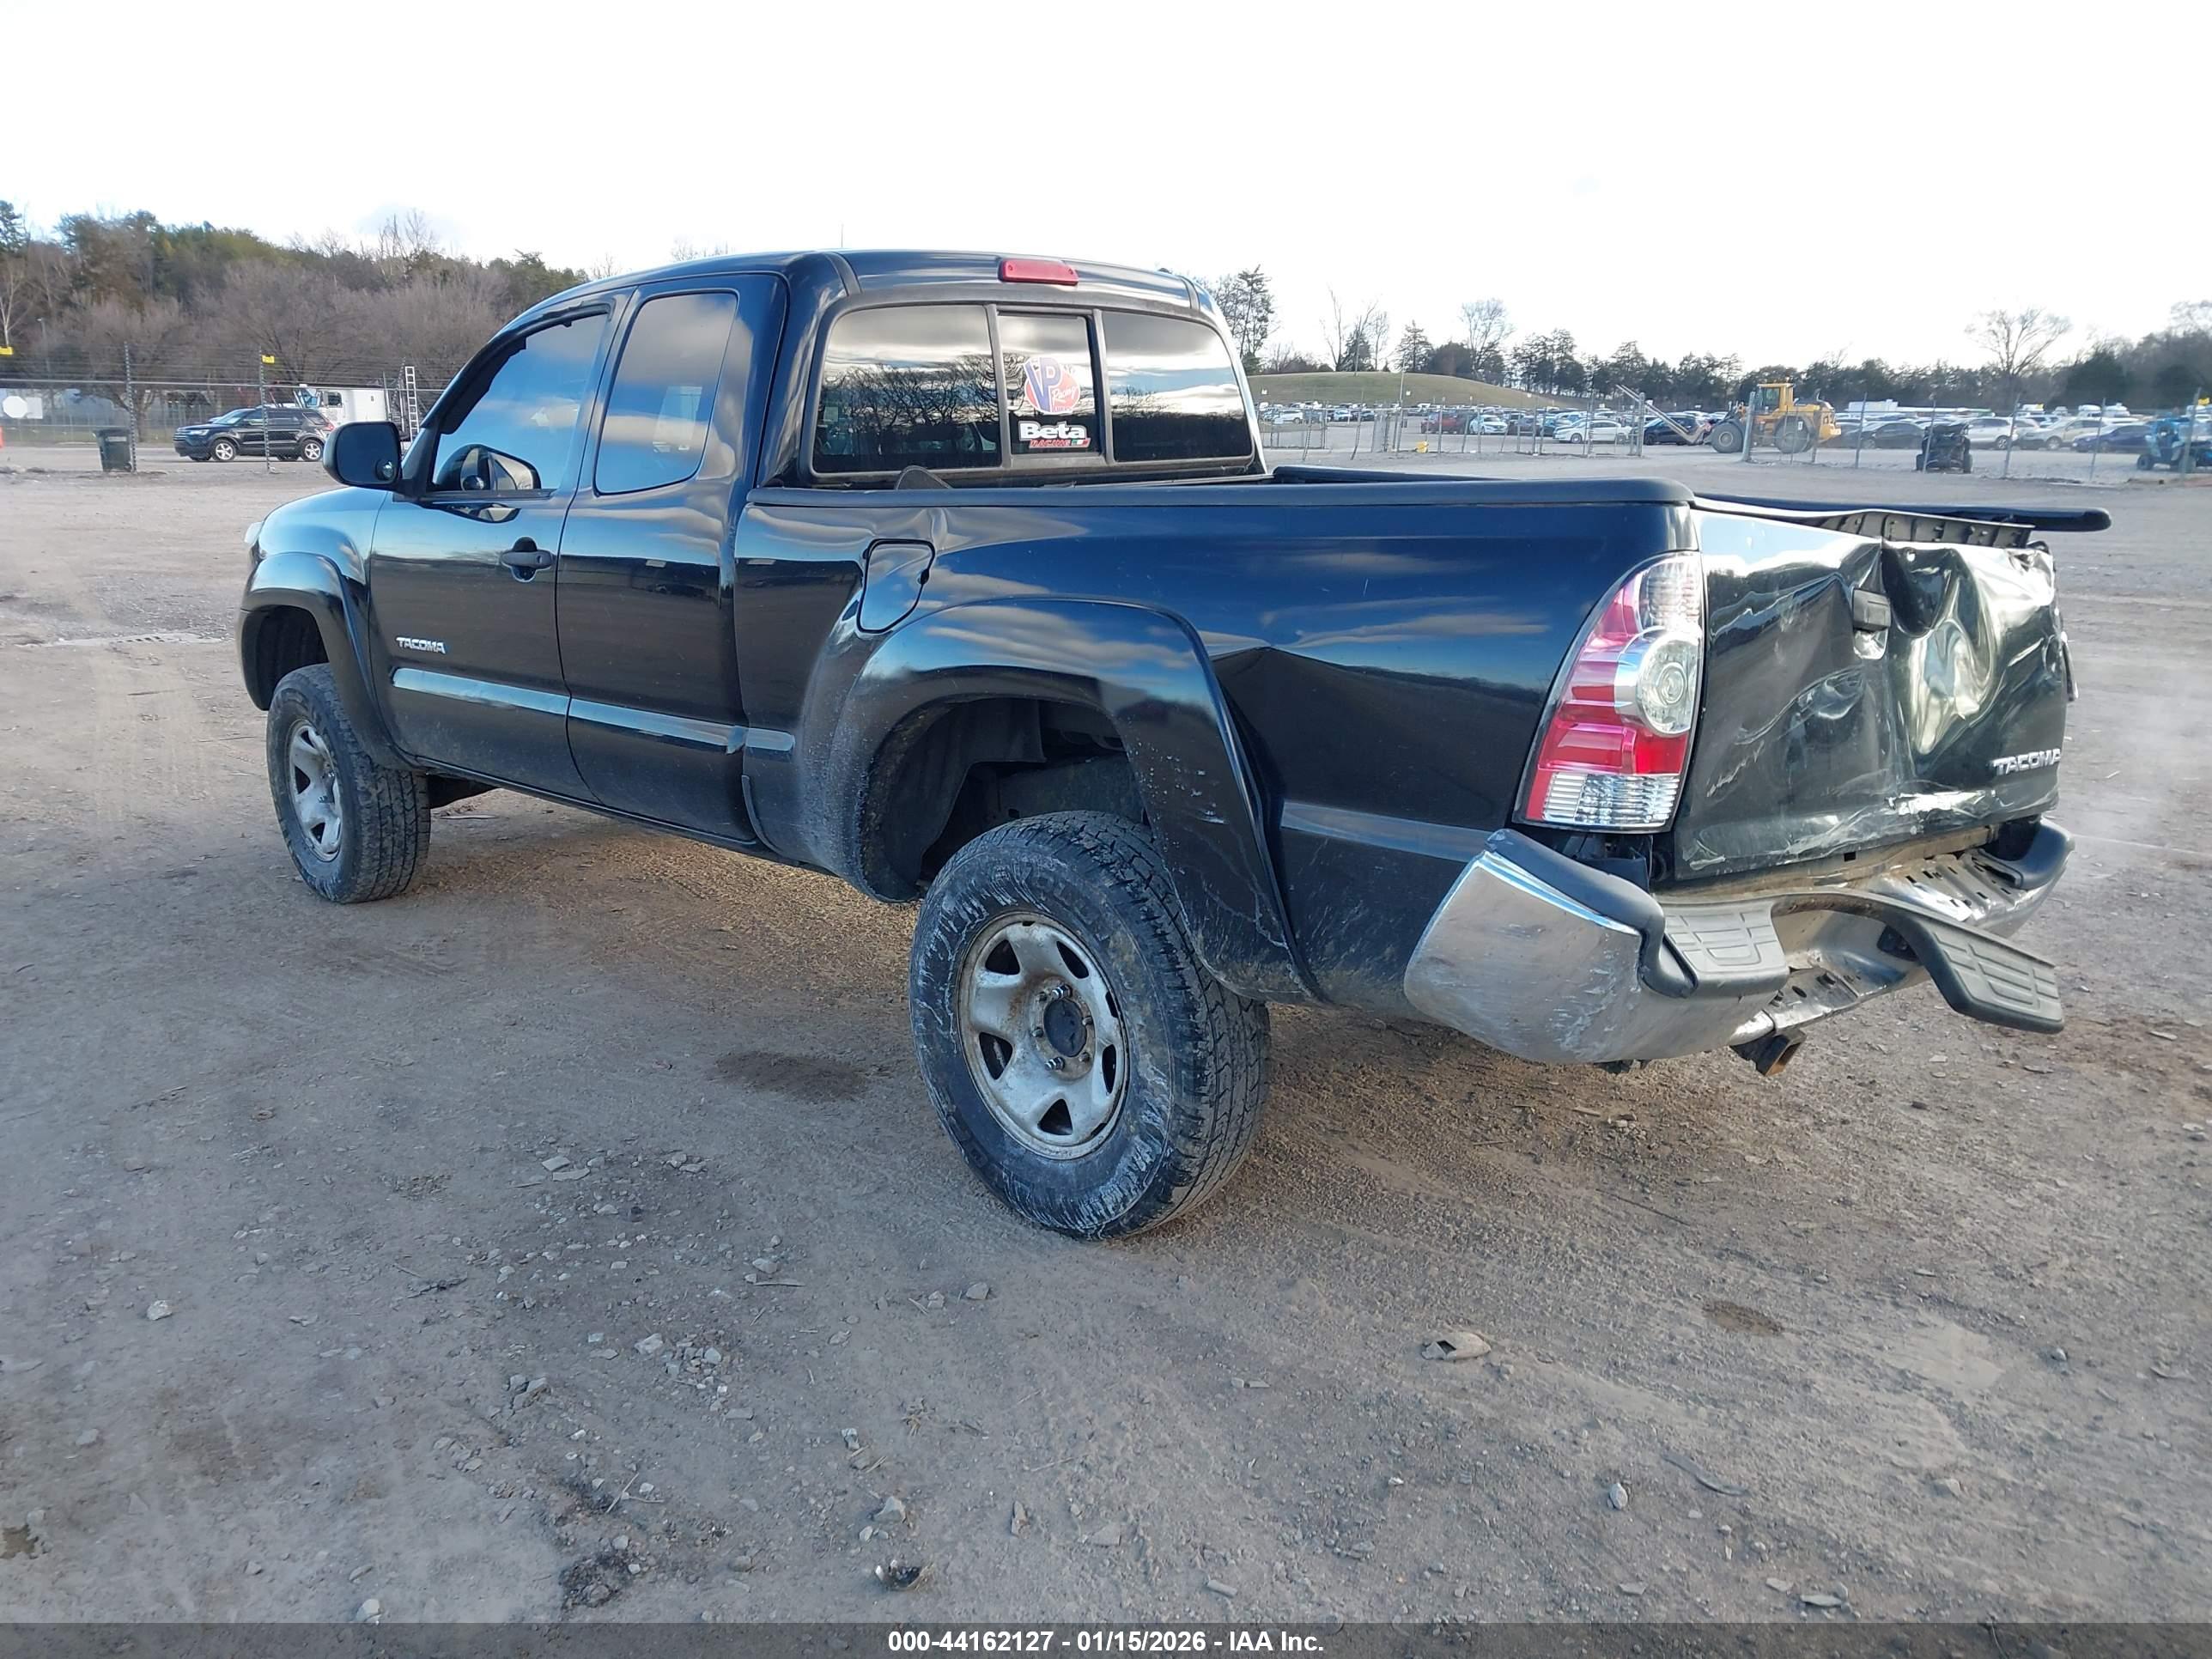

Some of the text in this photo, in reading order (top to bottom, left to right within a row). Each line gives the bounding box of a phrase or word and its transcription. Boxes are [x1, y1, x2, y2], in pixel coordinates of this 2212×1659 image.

[1024, 356, 1062, 413] VP
[1019, 421, 1086, 440] Beta
[396, 636, 446, 654] TACOMA
[1992, 748, 2062, 775] TACOMA
